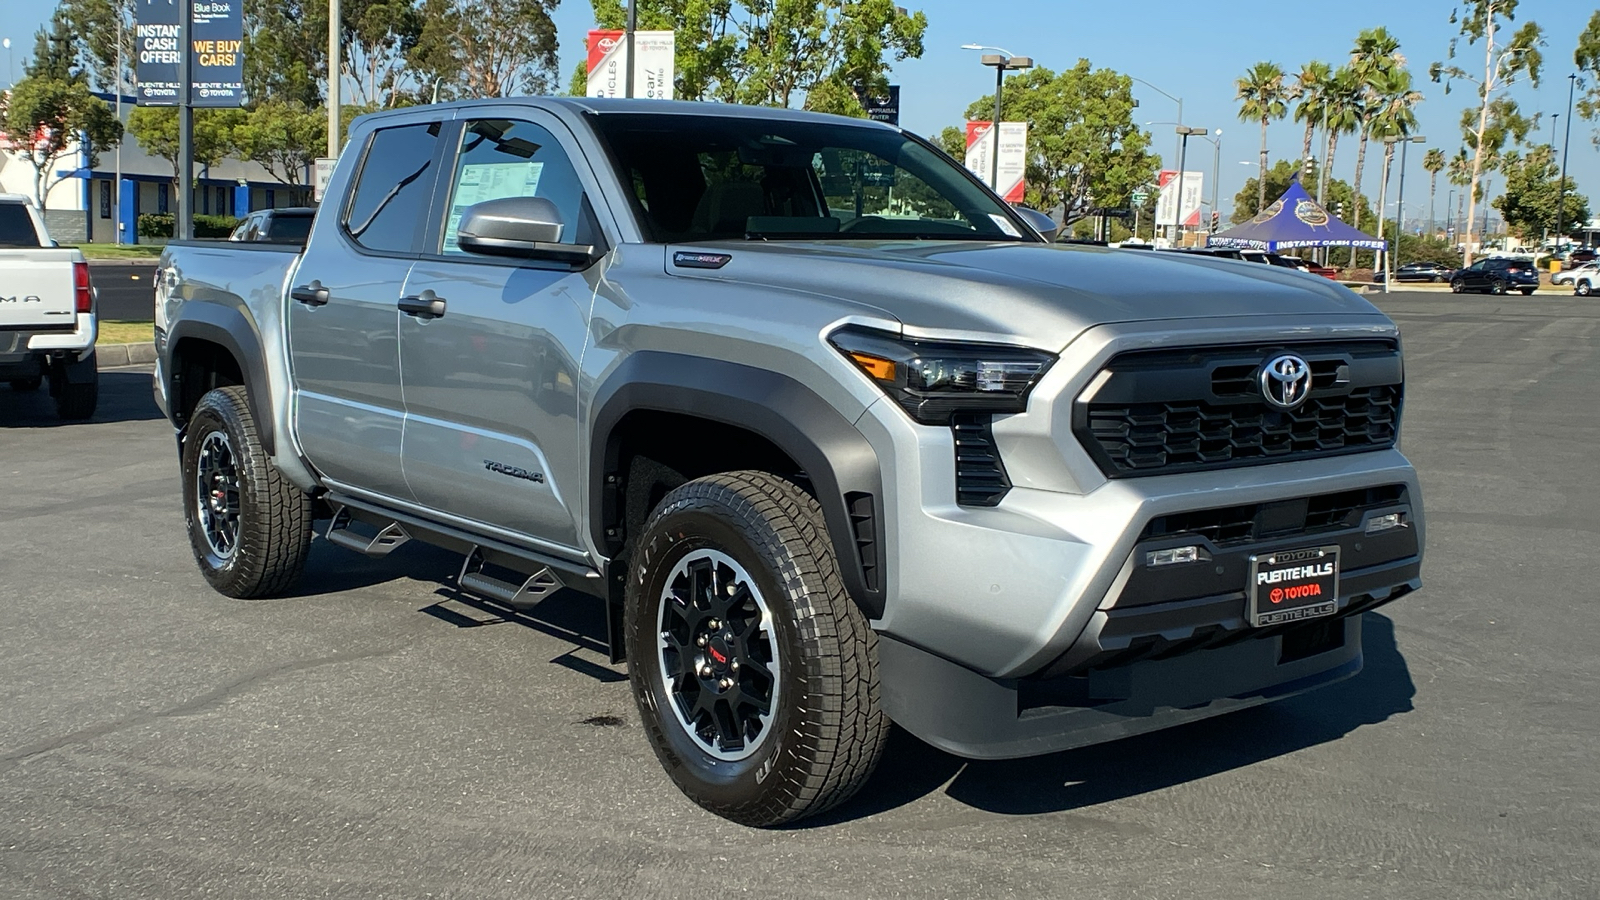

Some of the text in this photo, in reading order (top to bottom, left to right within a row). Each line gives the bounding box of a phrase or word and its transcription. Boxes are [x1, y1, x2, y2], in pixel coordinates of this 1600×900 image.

[193, 3, 231, 12] Blue Book
[144, 38, 177, 50] CASH
[193, 41, 241, 53] WE BUY
[140, 51, 181, 63] OFFER!
[199, 54, 236, 66] CARS!
[979, 140, 987, 174] VEHICLES
[1276, 240, 1320, 249] INSTANT
[1352, 240, 1384, 249] OFFER
[483, 459, 544, 484] TACOMA
[1276, 549, 1319, 561] TOYOTA
[1257, 562, 1333, 585] PUENTE HILLS
[1284, 584, 1321, 600] TOYOTA
[1259, 604, 1333, 625] PUENTE HILLS
[709, 646, 727, 663] TRD
